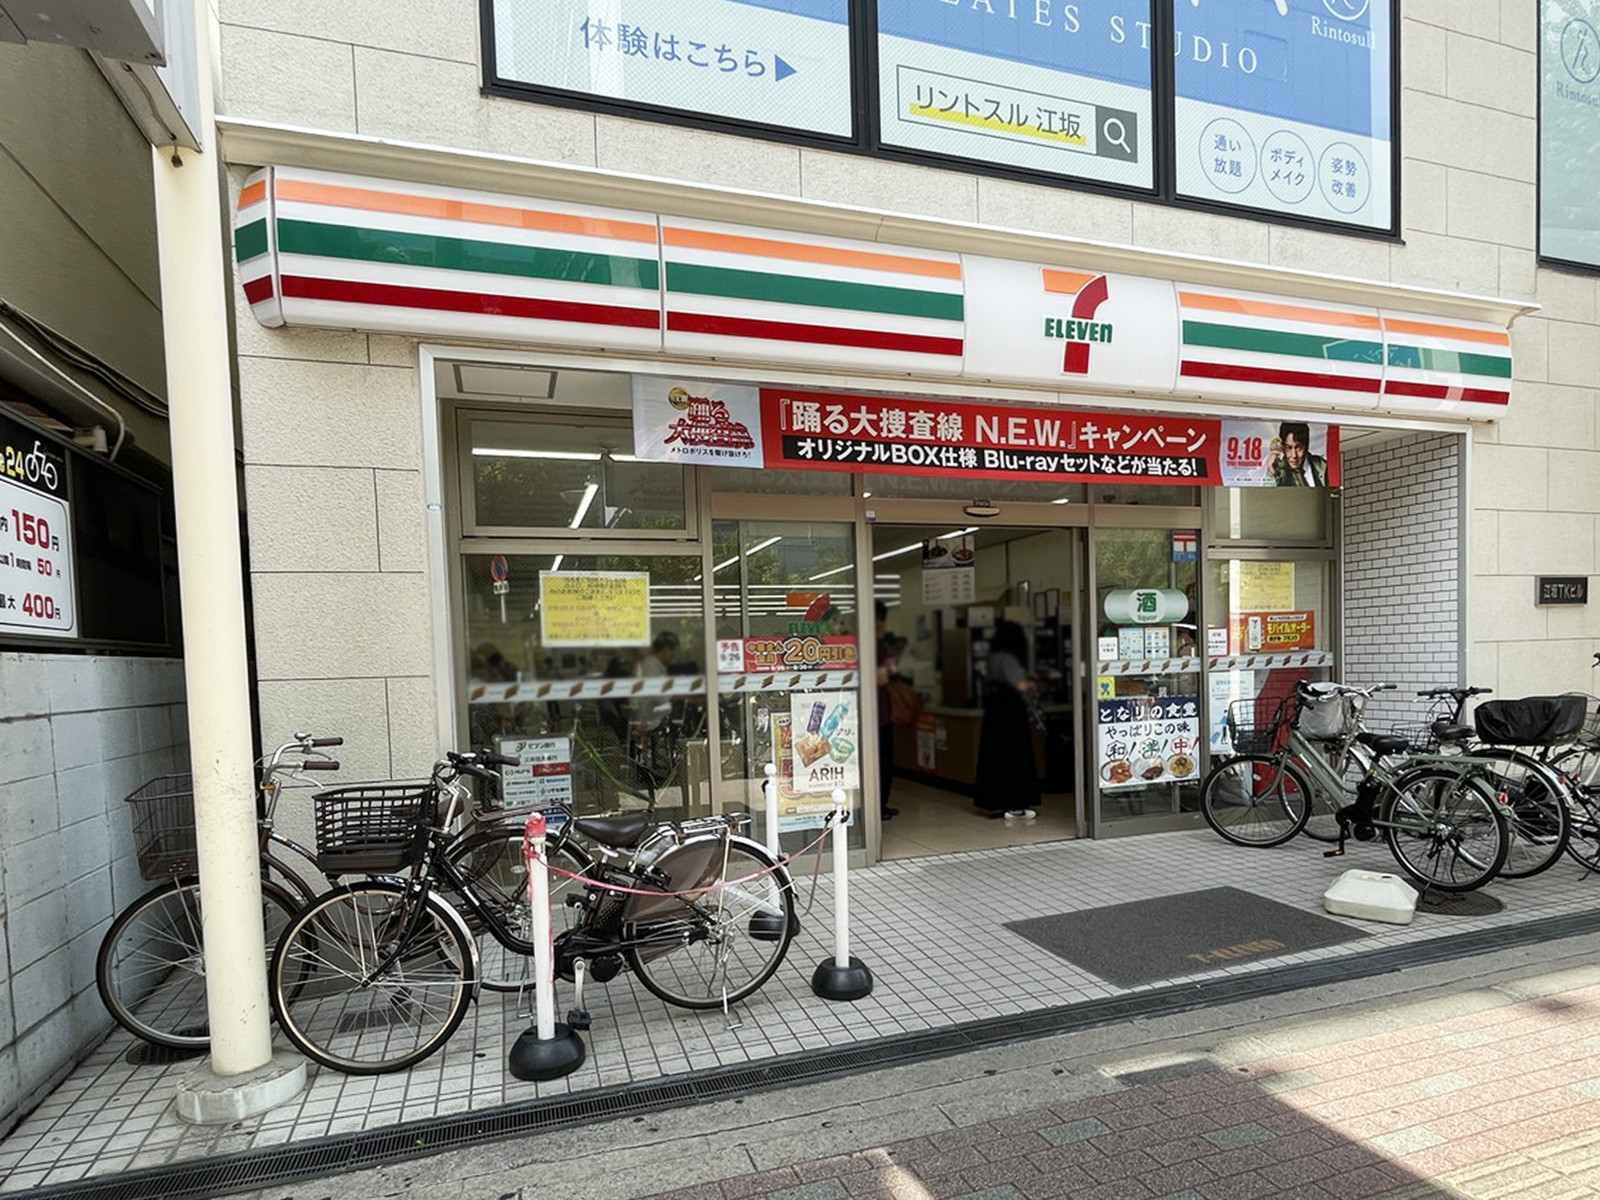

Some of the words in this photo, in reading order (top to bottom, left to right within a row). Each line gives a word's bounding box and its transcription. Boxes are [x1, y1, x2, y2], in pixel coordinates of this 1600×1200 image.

[580, 16, 766, 77] 体験はこちら
[916, 85, 1029, 127] リントスル
[1036, 107, 1082, 139] 江坂
[1214, 134, 1242, 151] 通い
[1214, 156, 1242, 178] 放題
[1270, 149, 1304, 168] ボディ
[1331, 157, 1357, 177] 姿勢
[1270, 169, 1305, 186] メイク
[1331, 179, 1357, 198] 改善
[1044, 317, 1113, 344] ELEVEN
[780, 398, 964, 442] 『踊る大捜査線
[797, 440, 977, 469] オリジナルBOX仕様
[984, 450, 1199, 477] Blu-rayセットなどが当たる!
[1226, 436, 1263, 461] 9.18
[1137, 592, 1157, 612] 酒
[1100, 702, 1197, 722] となりの食堂
[1105, 721, 1191, 740] やっぱりこの味
[809, 766, 845, 782] ARIH
